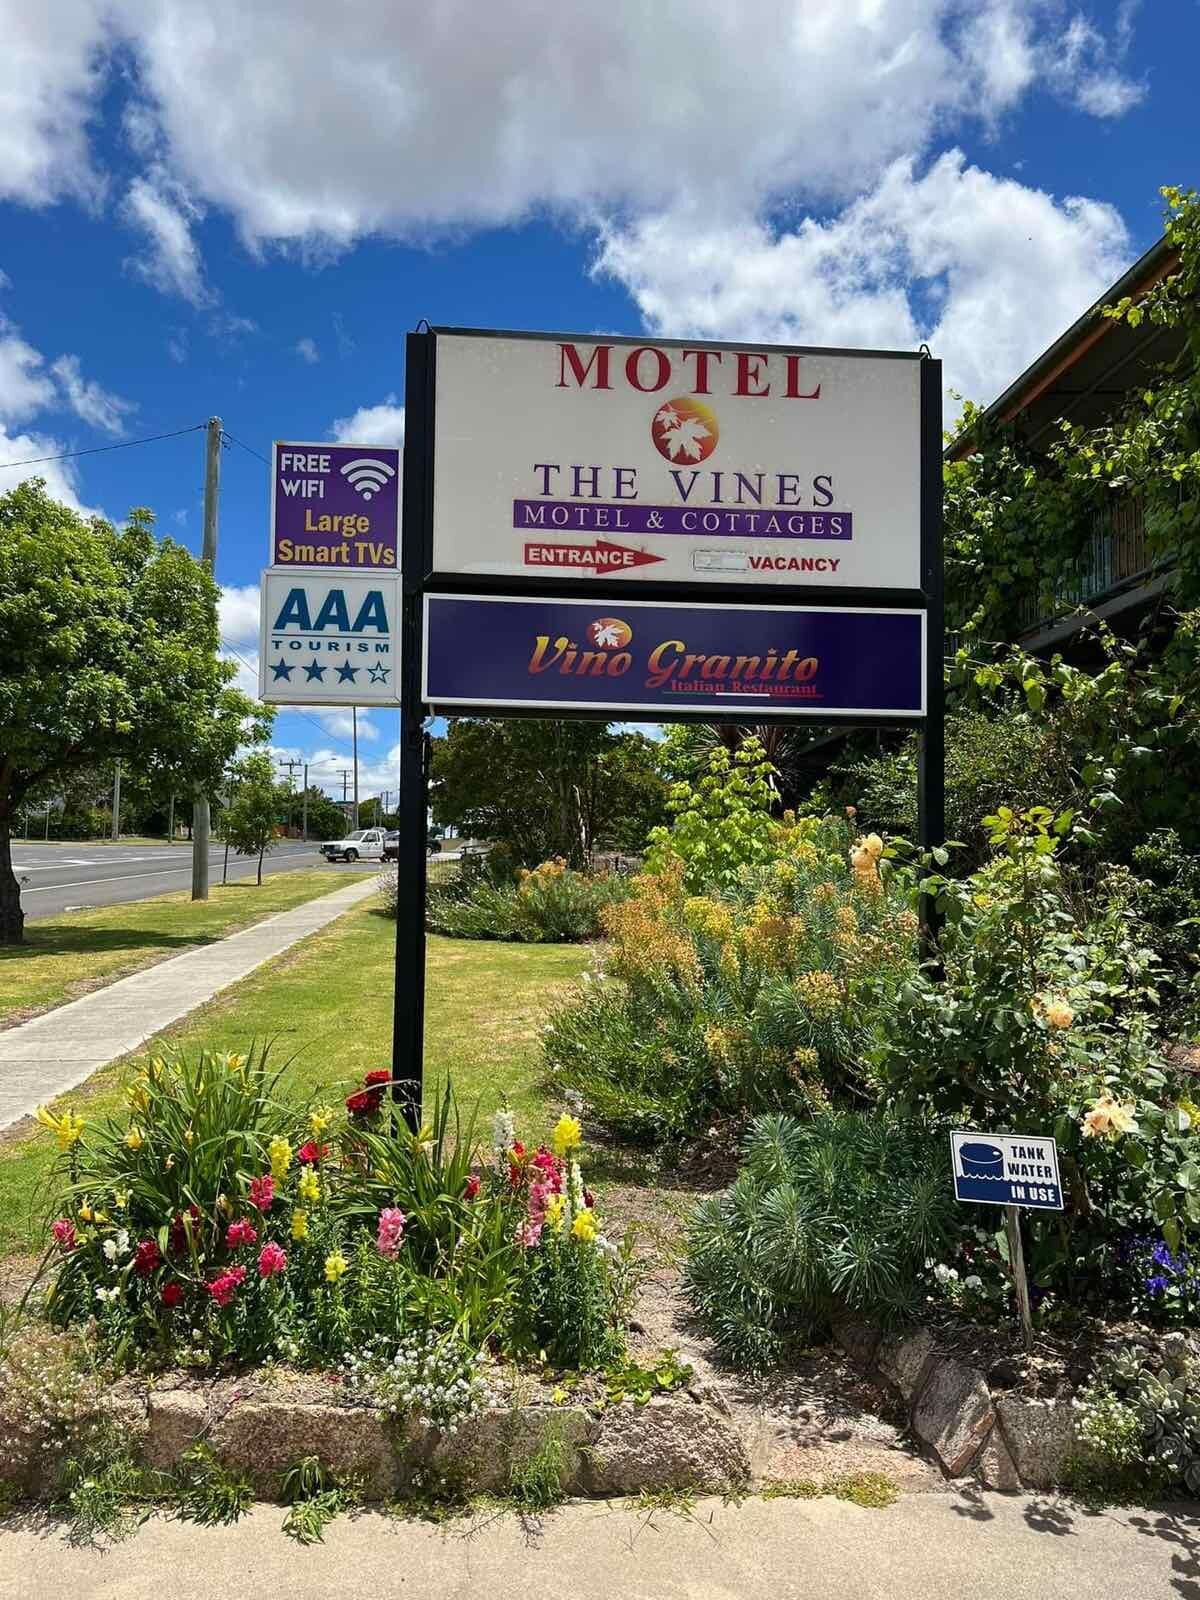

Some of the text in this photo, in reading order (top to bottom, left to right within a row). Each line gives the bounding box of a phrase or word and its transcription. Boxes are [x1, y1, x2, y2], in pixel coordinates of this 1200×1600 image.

[554, 343, 821, 399] MOTEL
[281, 453, 331, 473] FREE
[281, 479, 325, 498] WIFI
[533, 464, 834, 507] THE VINES
[305, 509, 370, 537] Large
[524, 505, 843, 535] MOTEL & COTTAGES
[278, 539, 395, 565] Smart TVs
[528, 548, 635, 565] ENTRANCE
[749, 556, 840, 572] VACANCY
[273, 588, 389, 633] AAA
[272, 640, 389, 653] TOURISM
[528, 636, 819, 688] Vino Granito
[671, 679, 817, 694] Italian Restaurant
[1010, 1145, 1045, 1160] TANK
[1007, 1162, 1053, 1179] WATER
[1011, 1185, 1056, 1202] IN USE
